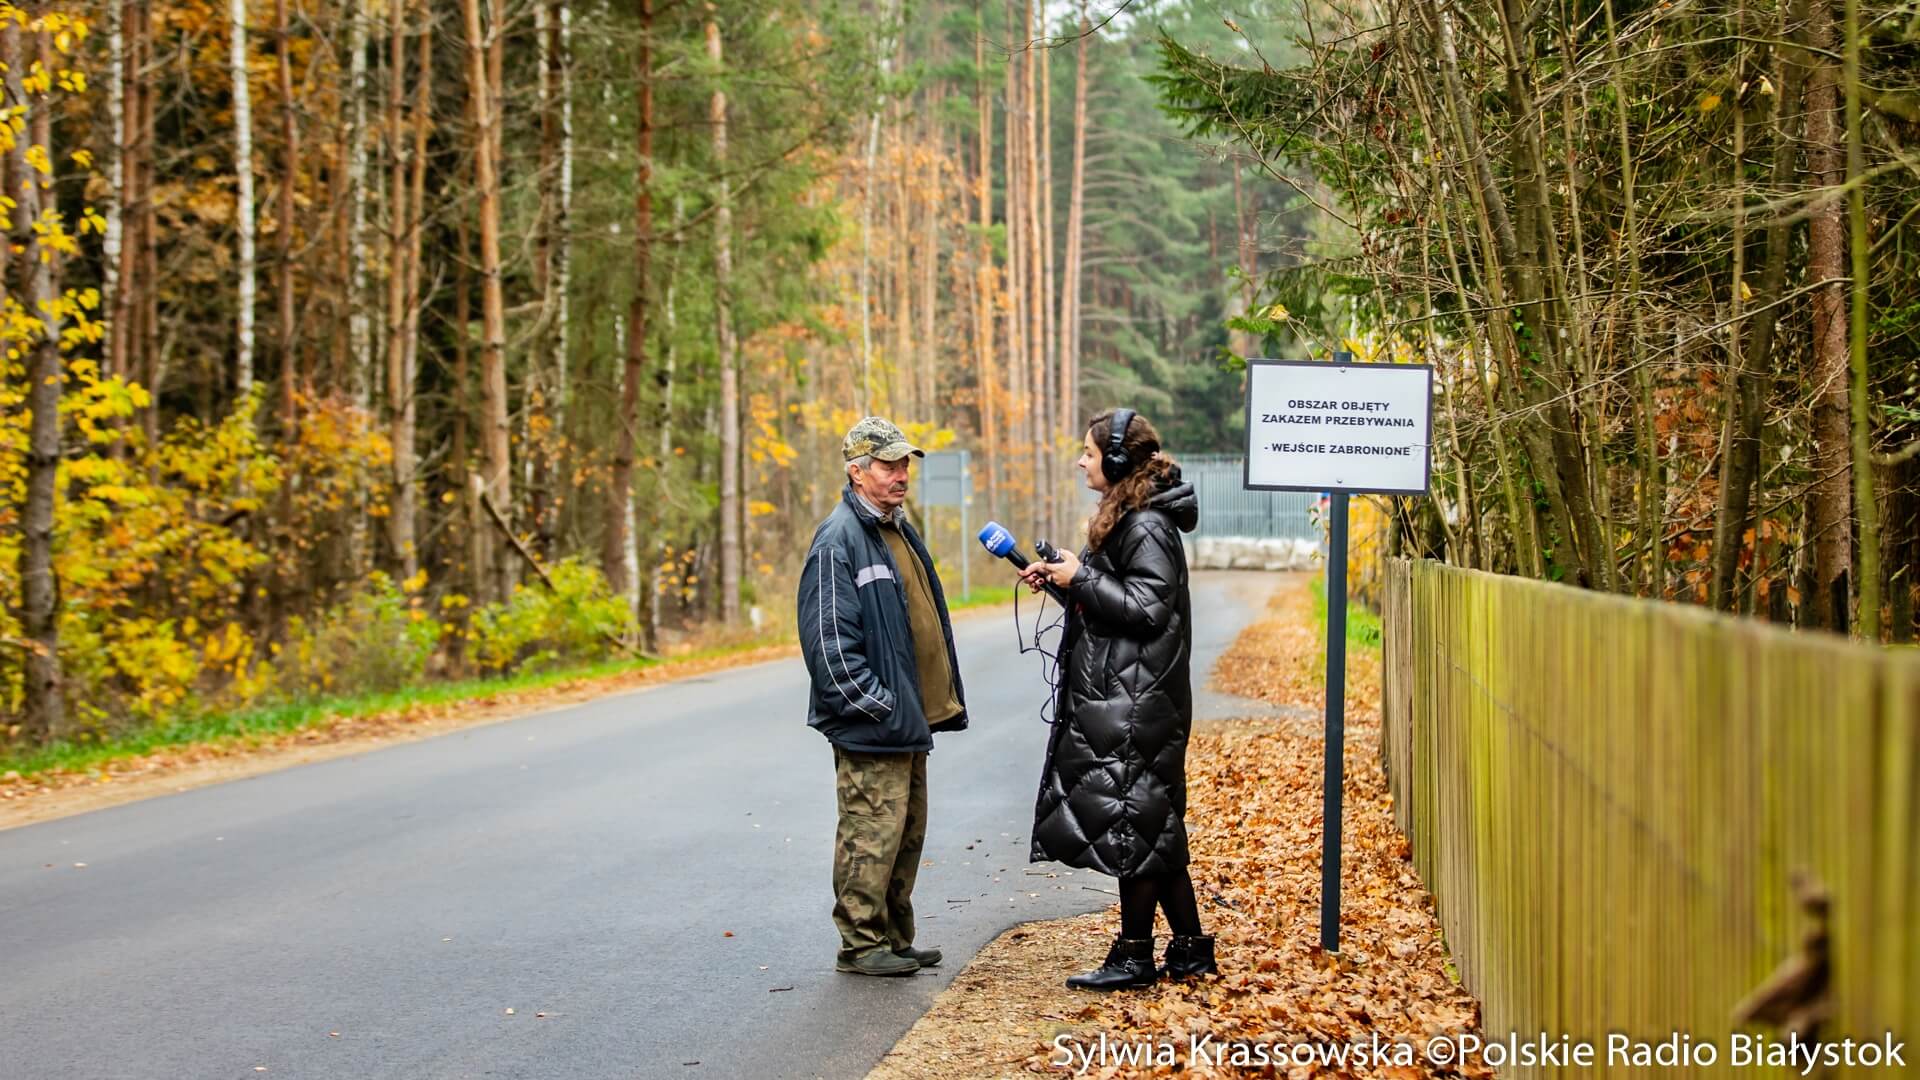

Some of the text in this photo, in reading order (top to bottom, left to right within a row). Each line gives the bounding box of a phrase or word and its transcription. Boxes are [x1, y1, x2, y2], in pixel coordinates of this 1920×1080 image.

[1288, 399, 1390, 413] OBSZAR OBJĘTY
[1262, 414, 1415, 427] ZAKAZEM PRZEBYWANIA
[1272, 442, 1326, 454] WEJŚCIE
[1329, 445, 1411, 456] ZABRONIONE
